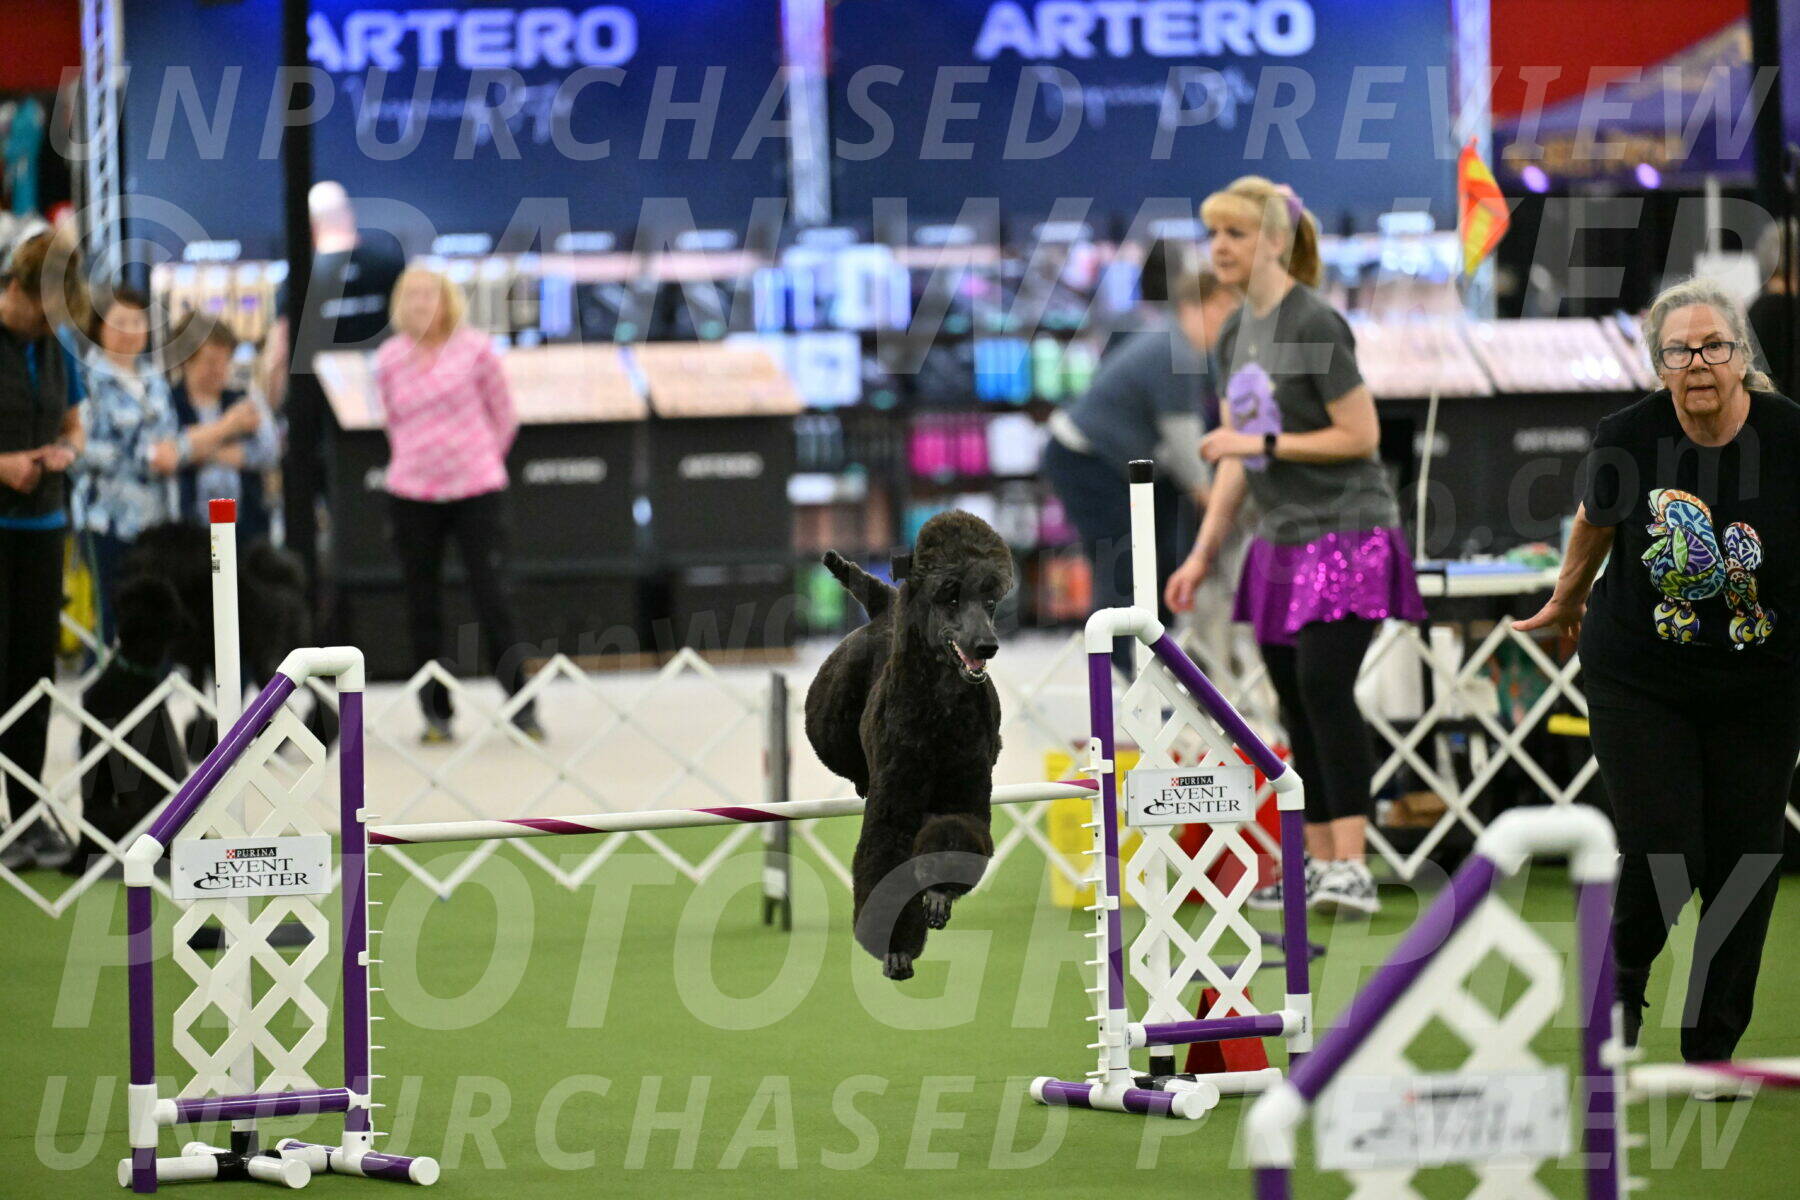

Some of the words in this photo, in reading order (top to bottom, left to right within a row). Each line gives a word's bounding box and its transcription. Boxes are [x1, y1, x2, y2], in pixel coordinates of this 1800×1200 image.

[972, 0, 1317, 60] ARTERO
[305, 6, 640, 72] ARTERO
[1179, 776, 1214, 786] PURINA
[1161, 786, 1228, 801] EVENT
[1143, 799, 1242, 816] CENTER
[236, 847, 277, 858] PURINA
[214, 858, 294, 875] EVENT
[193, 872, 310, 890] CENTER
